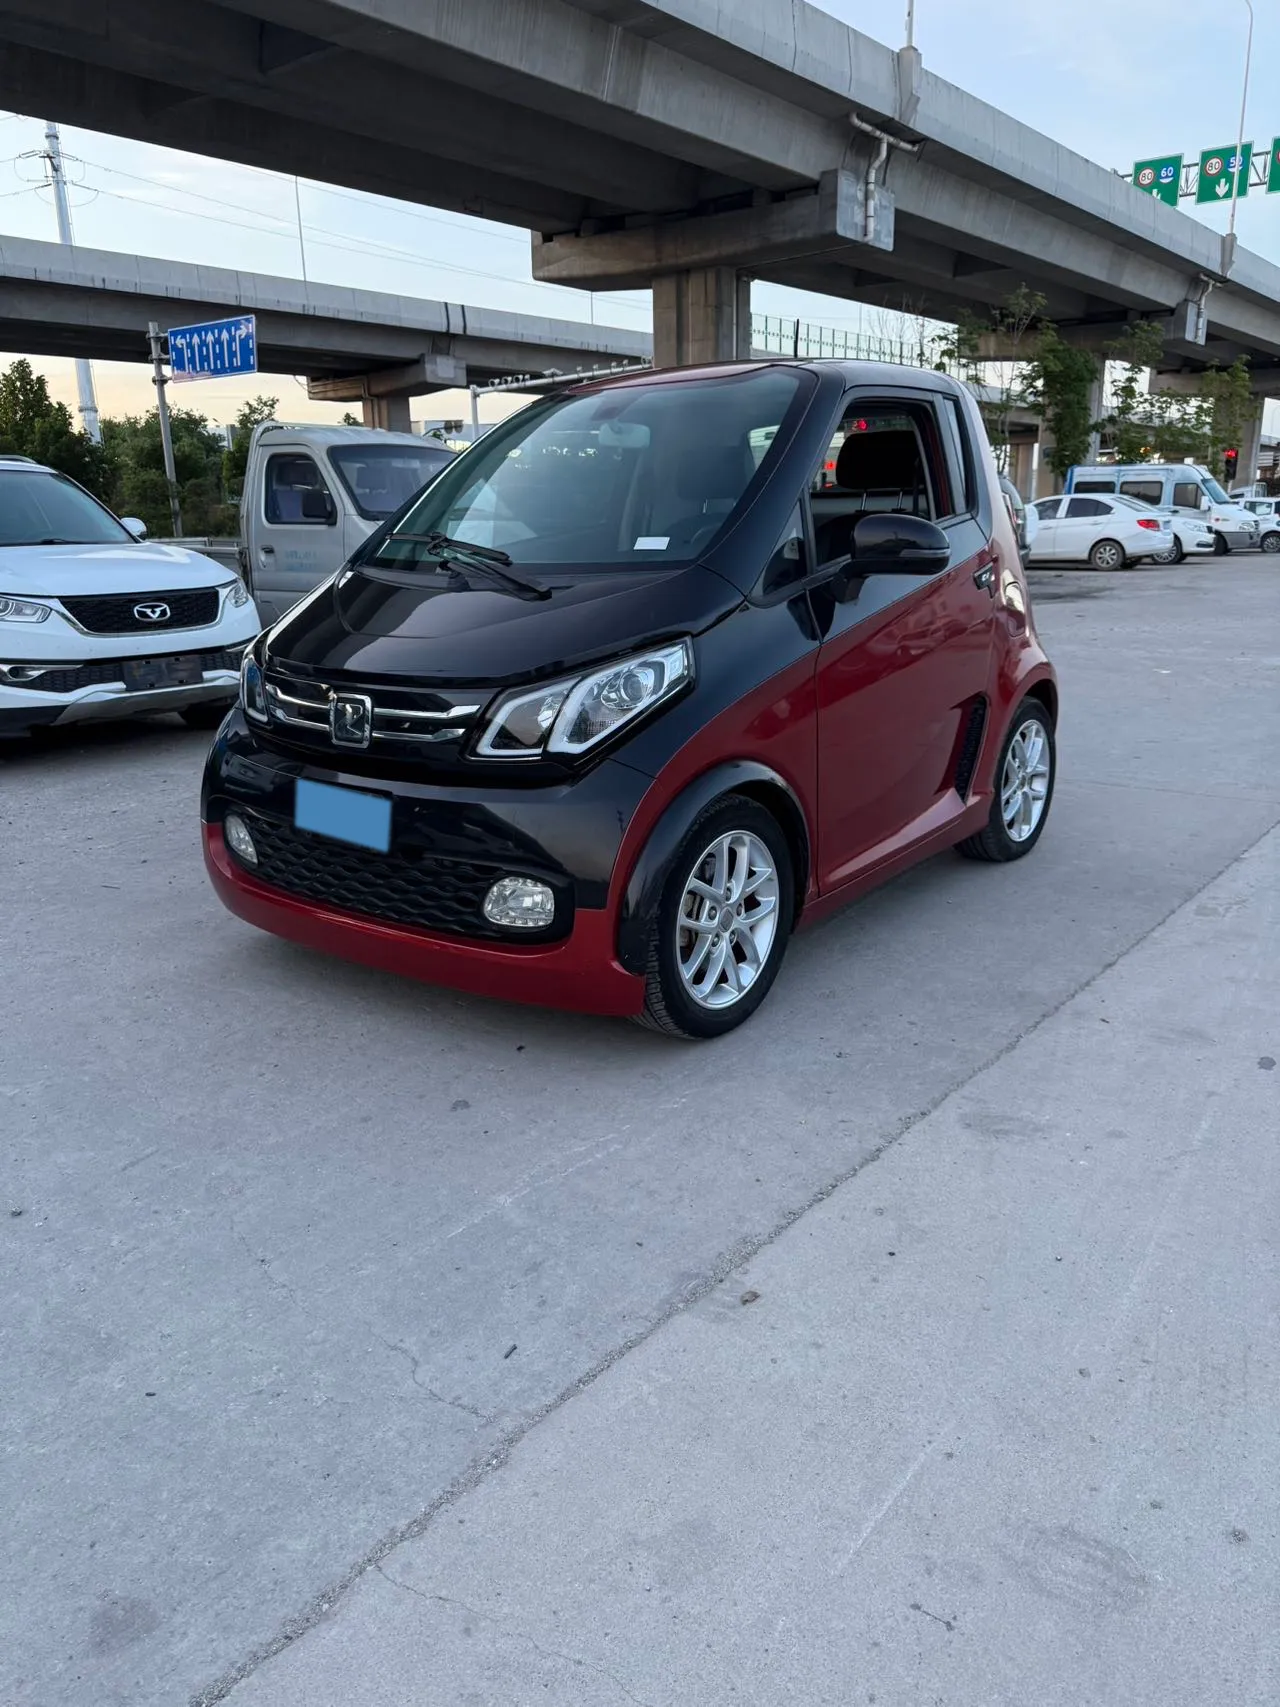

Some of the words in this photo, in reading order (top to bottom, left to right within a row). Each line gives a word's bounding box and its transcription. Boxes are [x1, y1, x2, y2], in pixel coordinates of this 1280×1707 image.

[1207, 161, 1220, 171] 80
[1140, 171, 1153, 183] 80
[1160, 166, 1174, 177] 60
